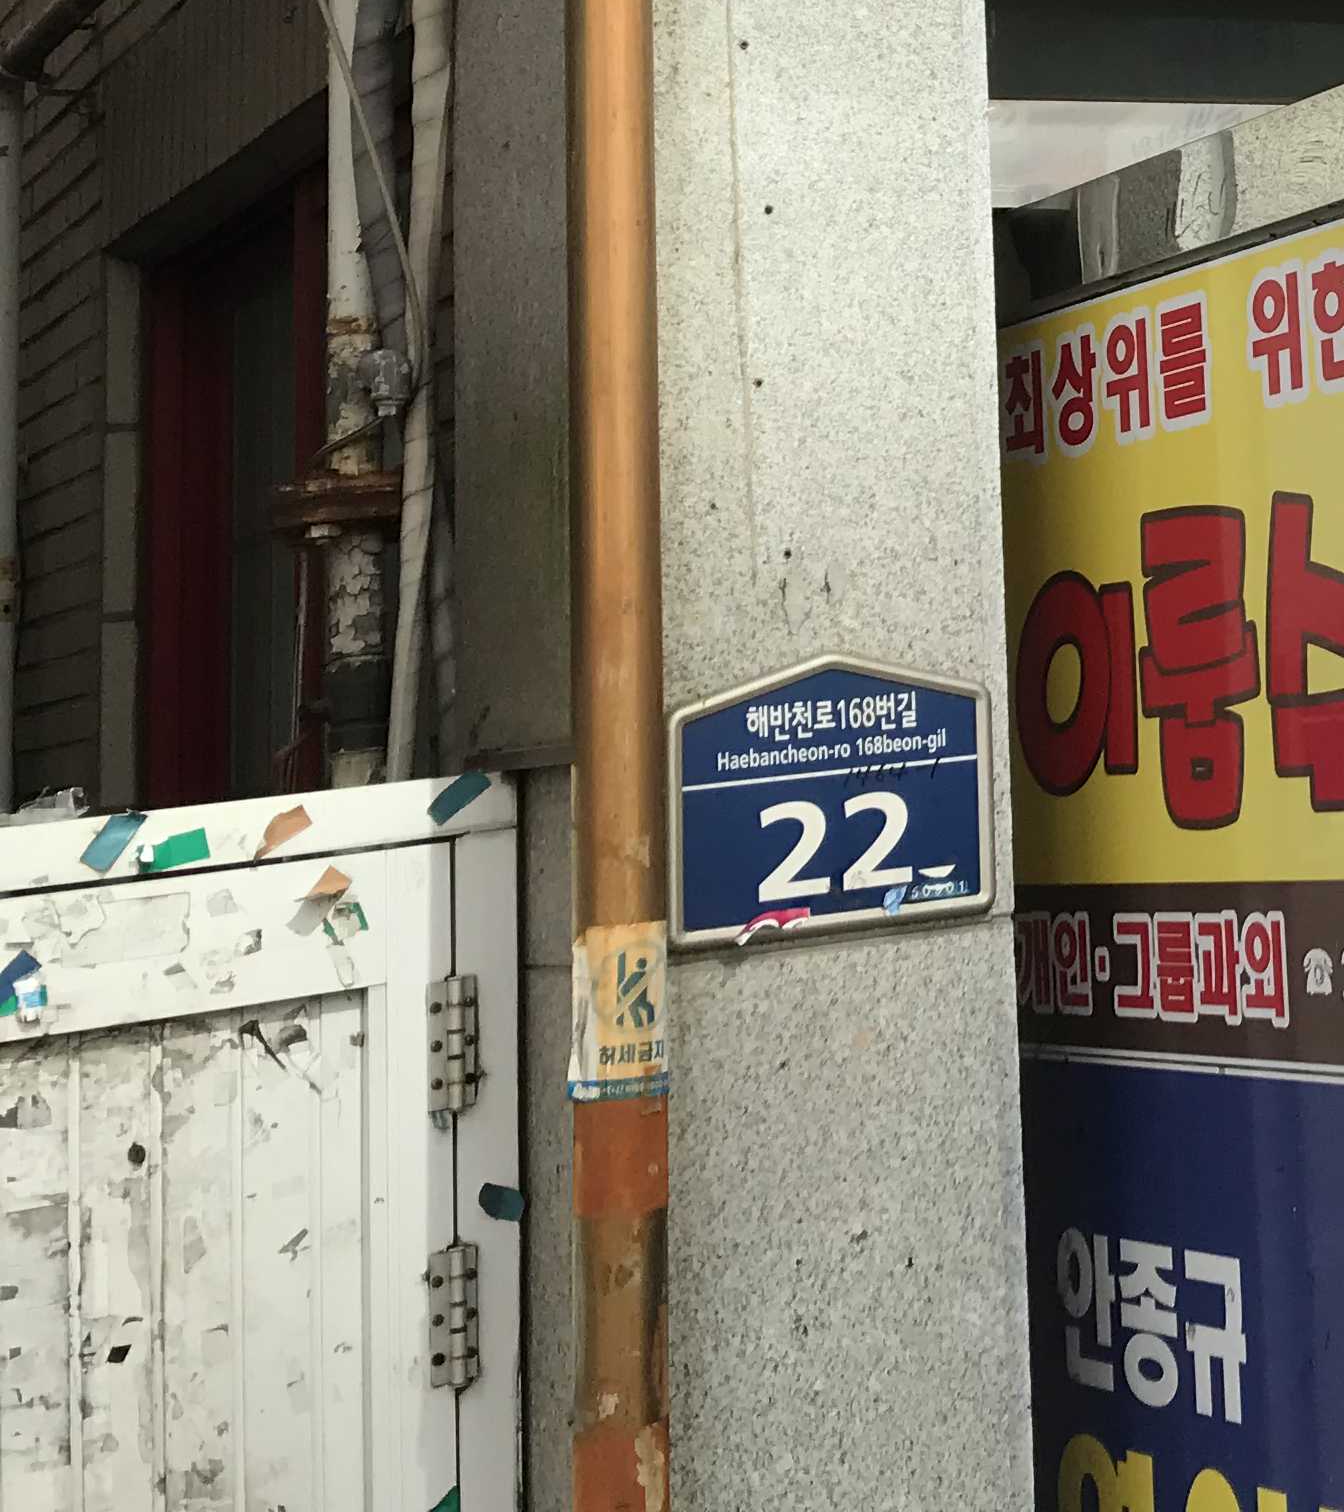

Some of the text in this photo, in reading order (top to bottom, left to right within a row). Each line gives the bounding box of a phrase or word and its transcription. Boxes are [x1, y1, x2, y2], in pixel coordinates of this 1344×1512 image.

[1004, 301, 1208, 456] 최상위를
[717, 742, 851, 772] Haebancheon-ro
[855, 728, 947, 757] 168beon-gil
[746, 690, 918, 742] 해반천로168번길
[758, 791, 913, 903] 22
[1056, 1227, 1248, 1424] 안종규
